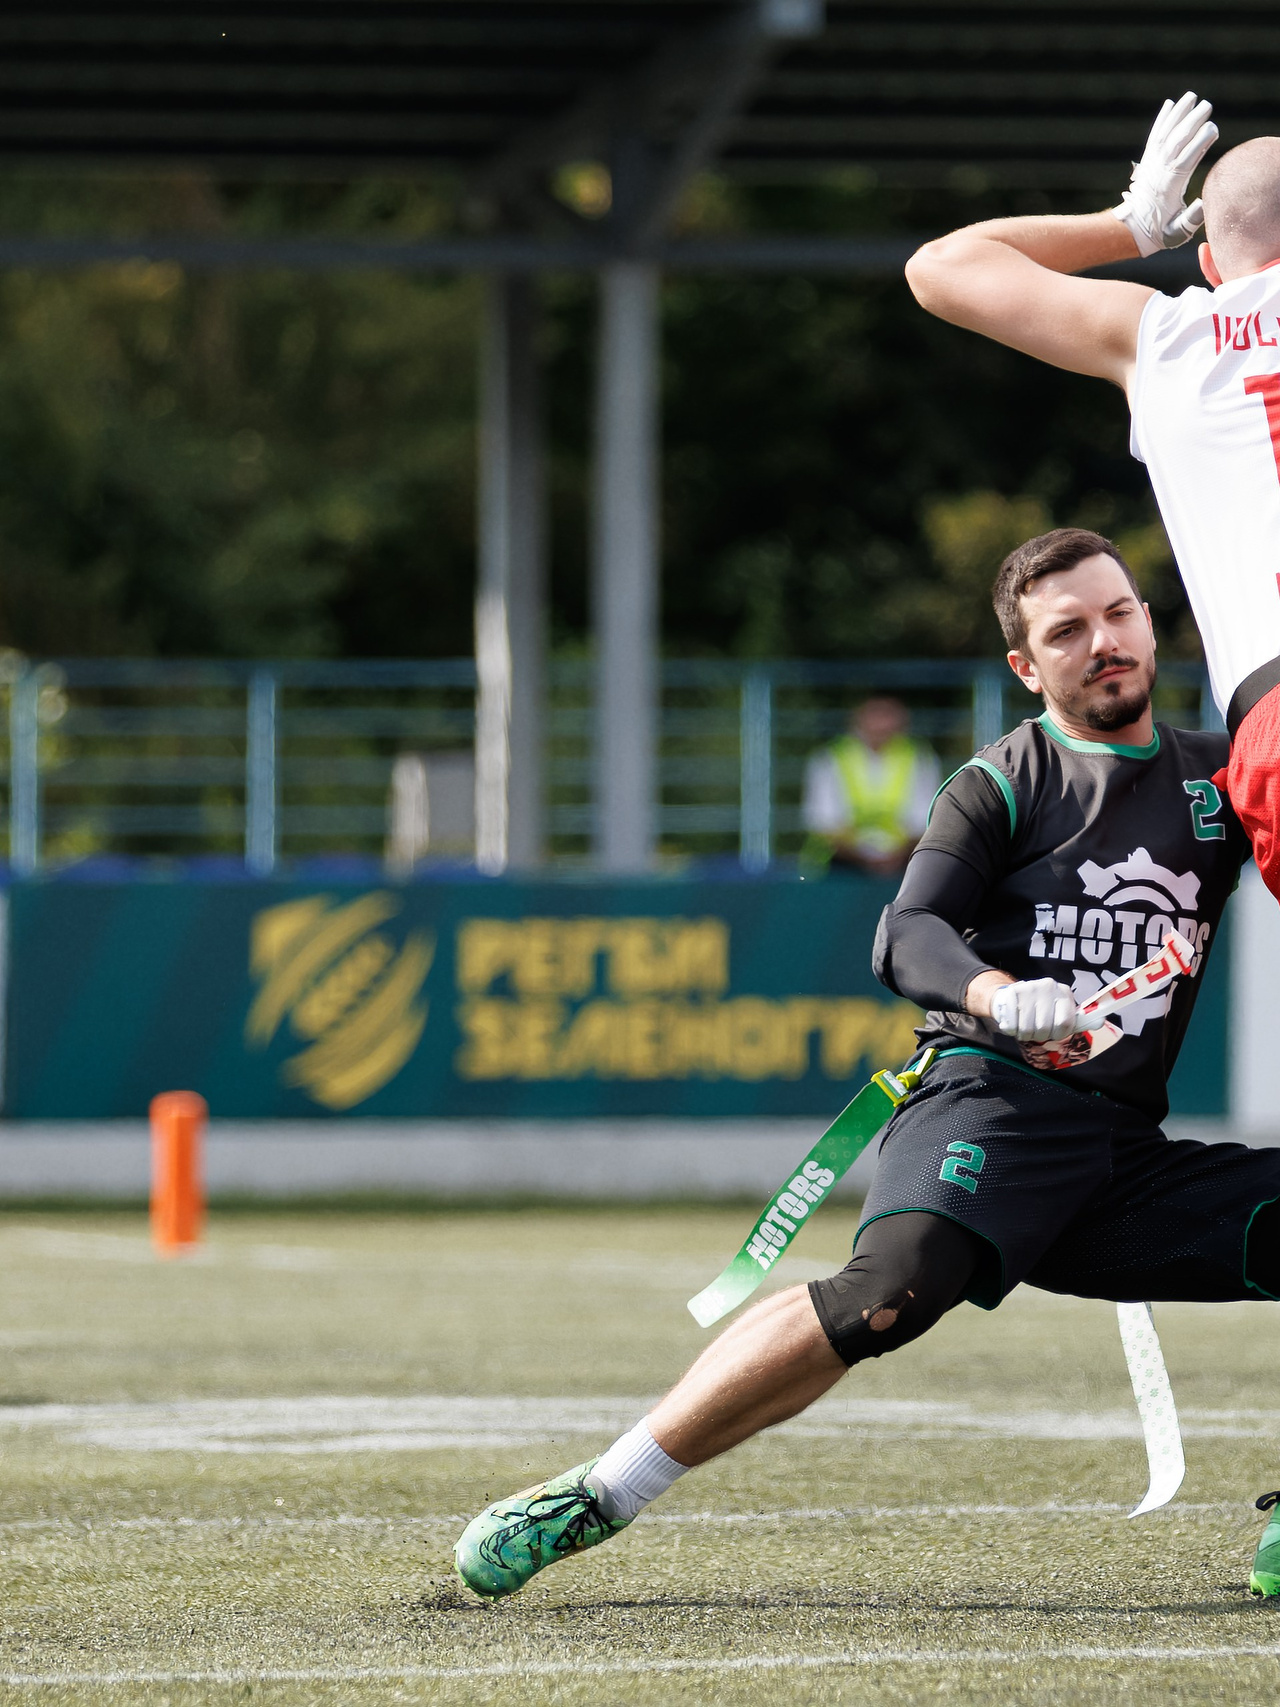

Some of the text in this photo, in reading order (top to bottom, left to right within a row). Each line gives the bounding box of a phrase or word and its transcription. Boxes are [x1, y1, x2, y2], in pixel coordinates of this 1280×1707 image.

[1183, 779, 1227, 841] 2
[456, 915, 729, 1001] РЕГБИ
[938, 1140, 987, 1194] 2
[746, 1160, 836, 1271] MOTORS
